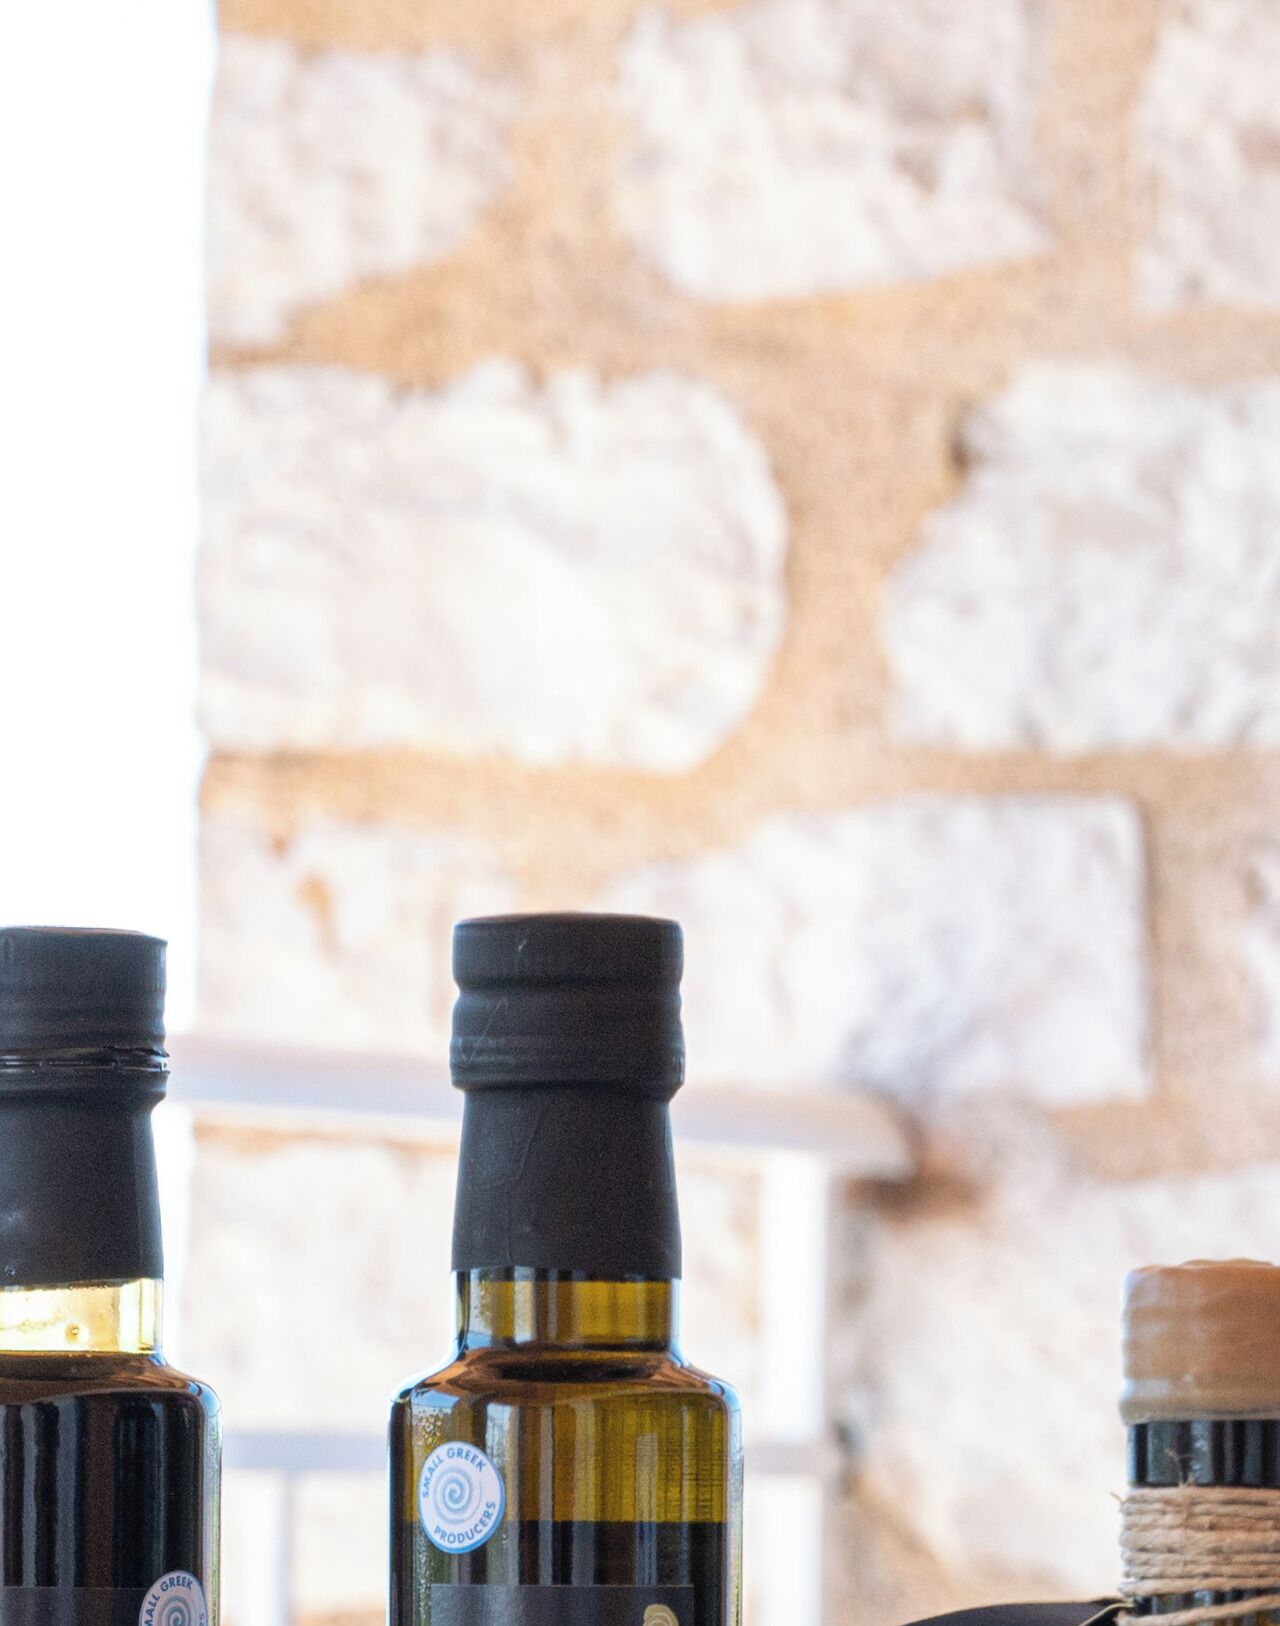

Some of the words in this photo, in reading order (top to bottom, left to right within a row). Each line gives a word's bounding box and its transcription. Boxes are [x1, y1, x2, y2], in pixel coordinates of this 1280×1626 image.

[423, 1455, 443, 1498] SMALL
[447, 1448, 486, 1472] GREEK
[434, 1501, 496, 1543] PRODUCERS
[160, 1576, 193, 1591] GREEK
